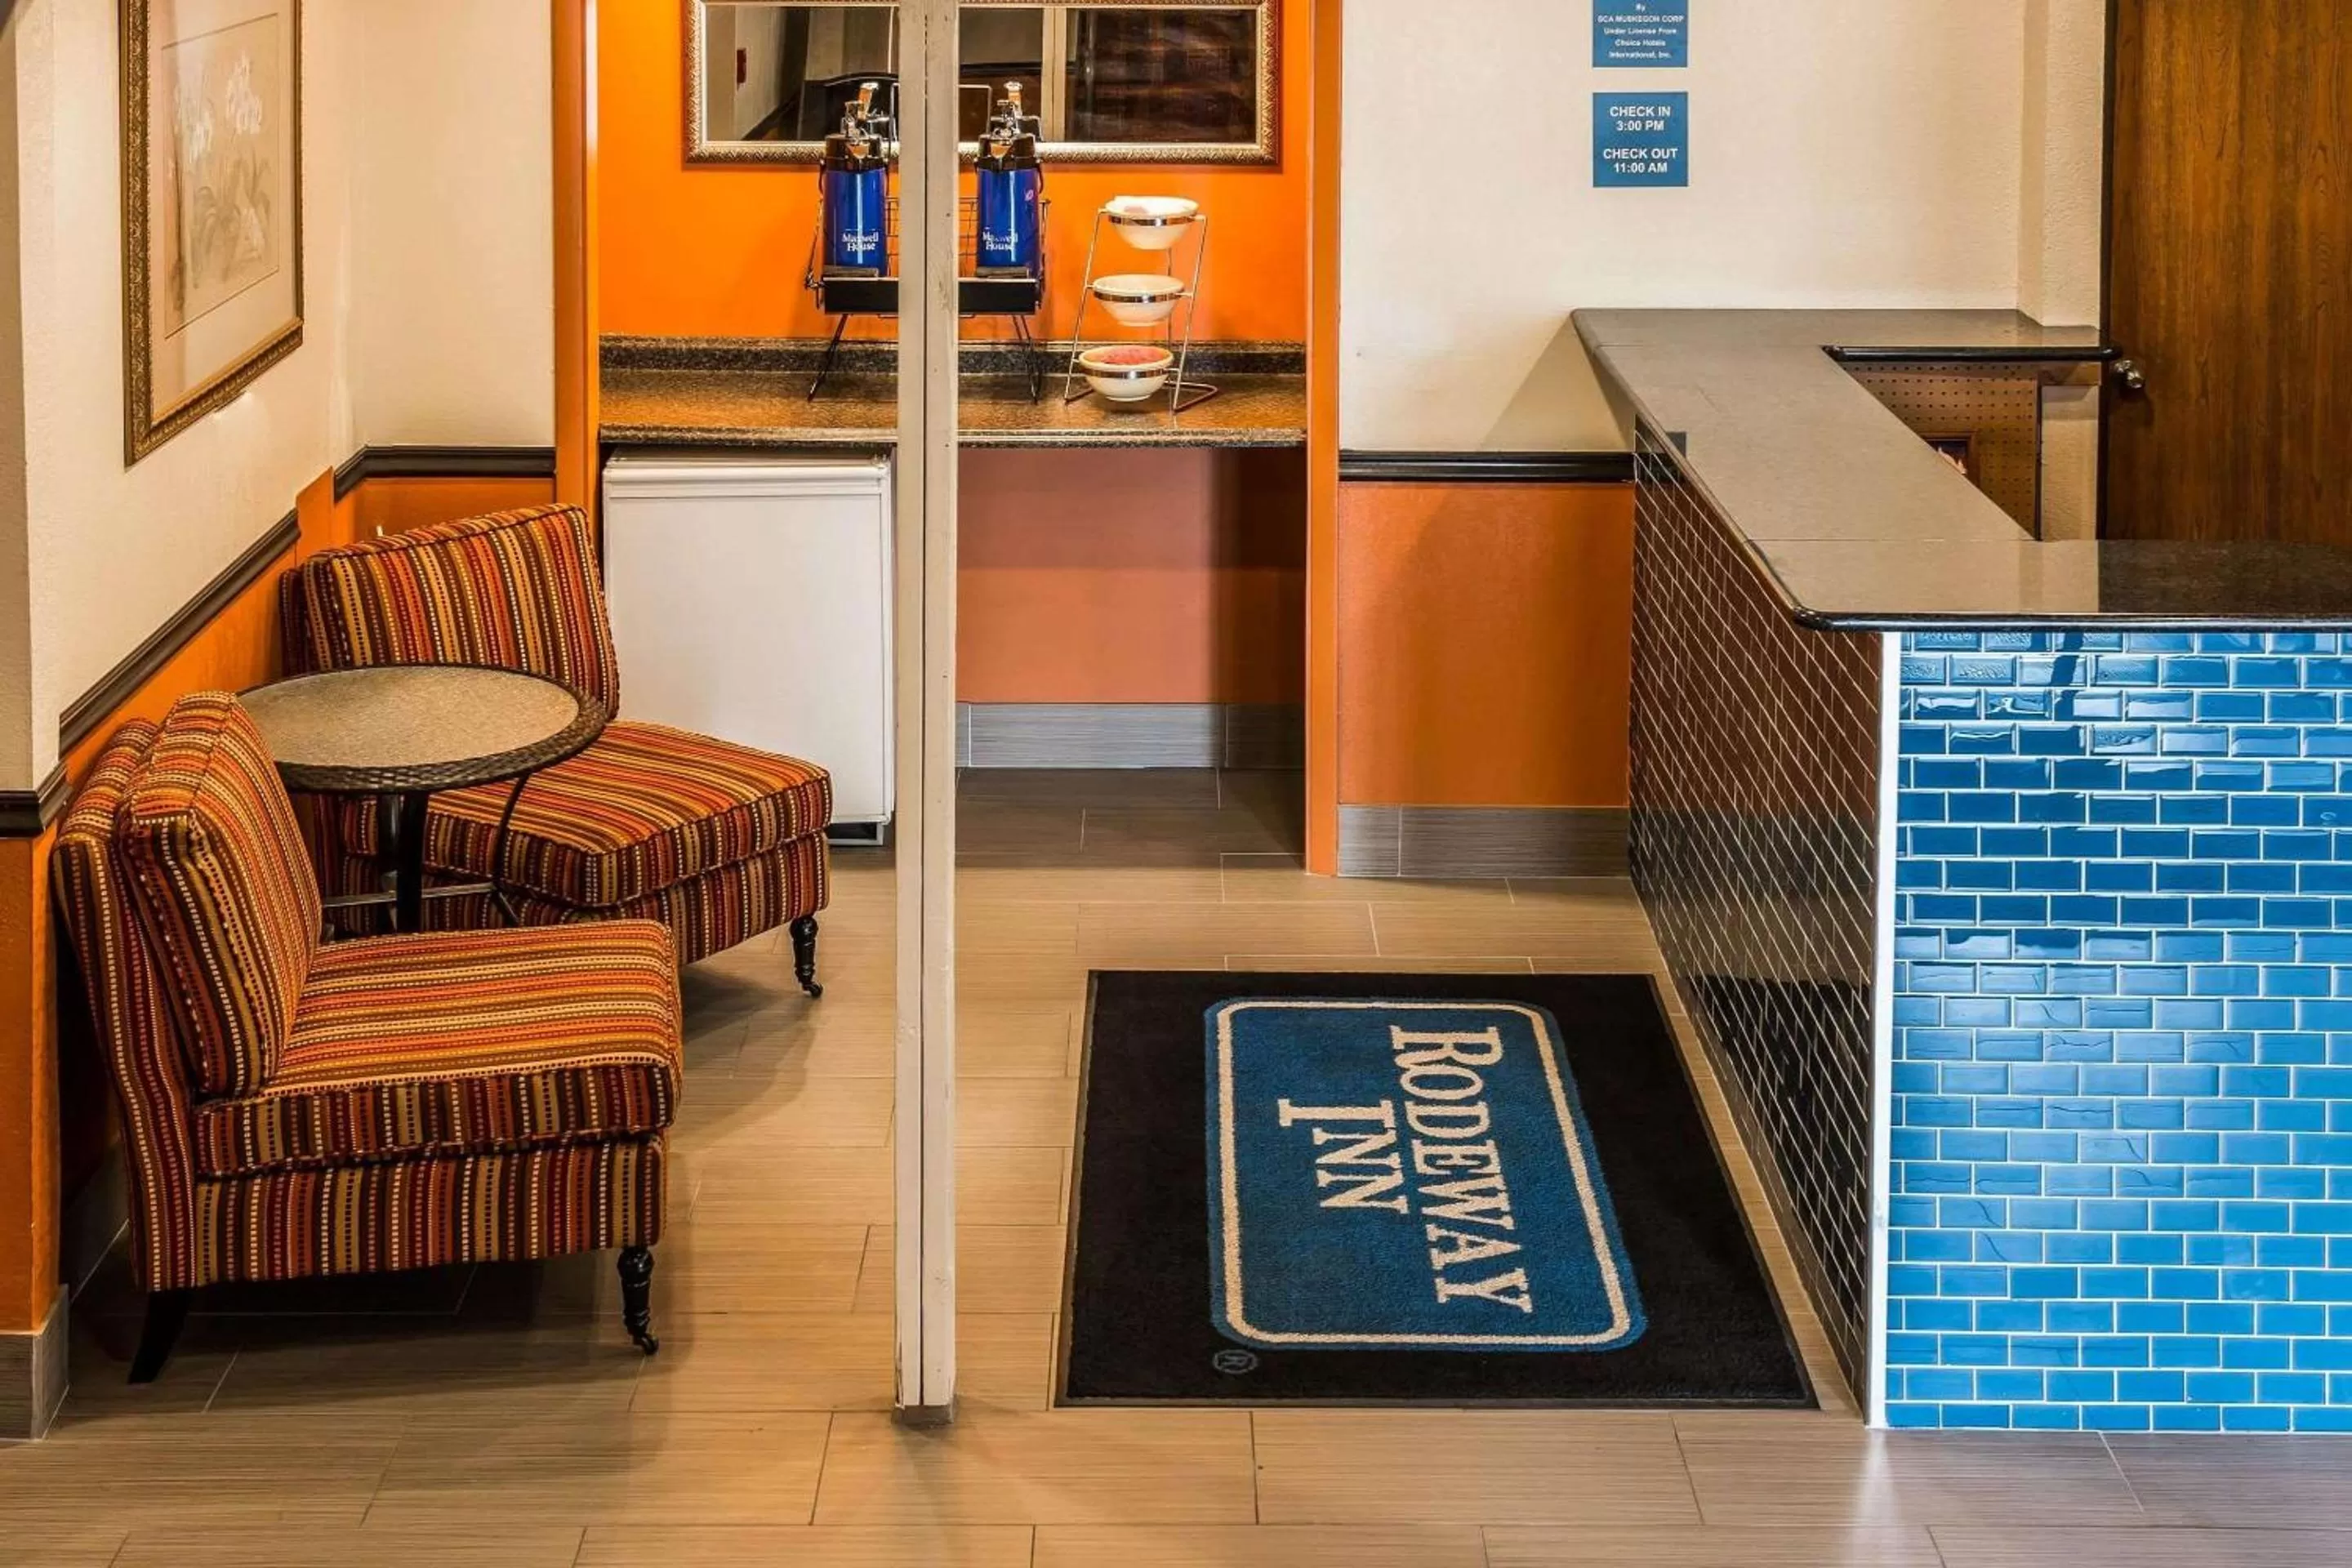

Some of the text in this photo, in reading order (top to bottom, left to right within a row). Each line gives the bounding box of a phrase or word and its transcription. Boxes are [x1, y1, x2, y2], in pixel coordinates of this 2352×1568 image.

[1610, 106, 1671, 117] CHECK IN
[1617, 121, 1664, 131] 3:00 PM
[1603, 149, 1678, 159] CHECK OUT
[1614, 163, 1668, 173] 11:00 AM
[842, 231, 879, 243] Mawell
[847, 243, 876, 252] House
[1277, 1098, 1409, 1214] INN
[1389, 1025, 1533, 1313] RODEWAY
